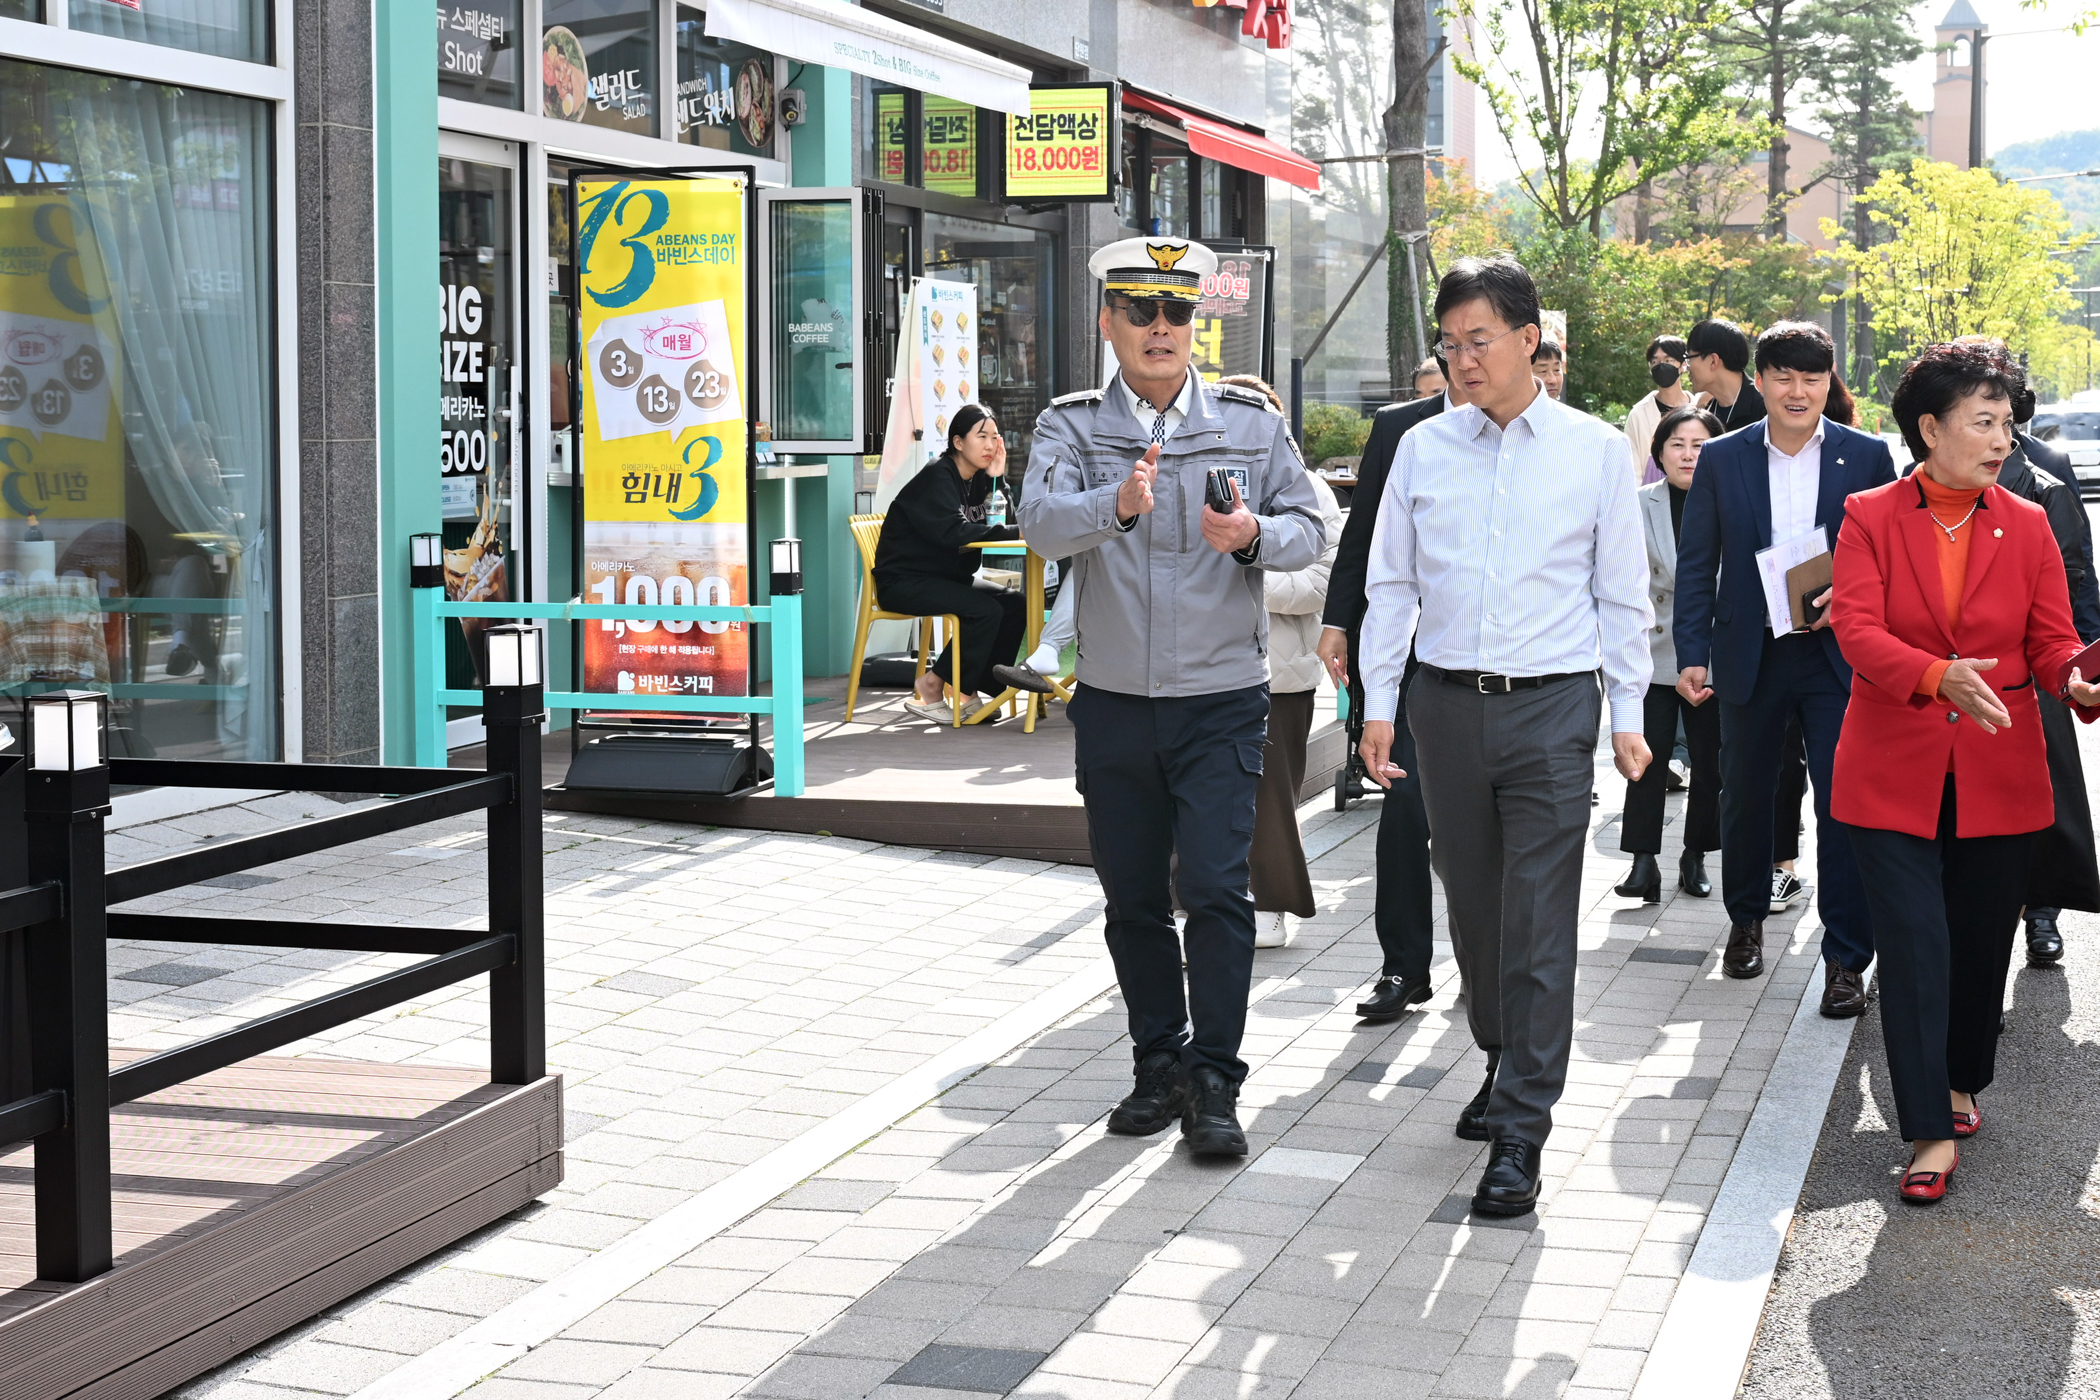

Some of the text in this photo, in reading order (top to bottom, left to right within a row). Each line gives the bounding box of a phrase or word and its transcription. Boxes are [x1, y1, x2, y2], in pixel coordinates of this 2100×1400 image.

[451, 7, 504, 44] 스페셜티
[444, 40, 483, 75] Shot
[833, 42, 870, 63] SPECIALTY
[872, 50, 891, 69] 2Shot
[898, 58, 912, 75] BIG
[924, 69, 941, 83] Coffee
[591, 69, 644, 111] 샐러드
[677, 78, 707, 97] ANDWICH
[622, 104, 646, 121] SALAD
[1015, 113, 1098, 141] 전담액상
[1014, 146, 1099, 172] 18.000원
[655, 233, 736, 246] ABEANS DAY
[656, 246, 735, 266] 바빈스데이
[788, 323, 833, 333] BABEANS
[662, 334, 692, 351] 매월
[792, 333, 830, 344] COFFEE
[440, 341, 484, 383] IZE
[591, 561, 636, 573] 아메리카노
[638, 674, 714, 694] 바빈스커피
